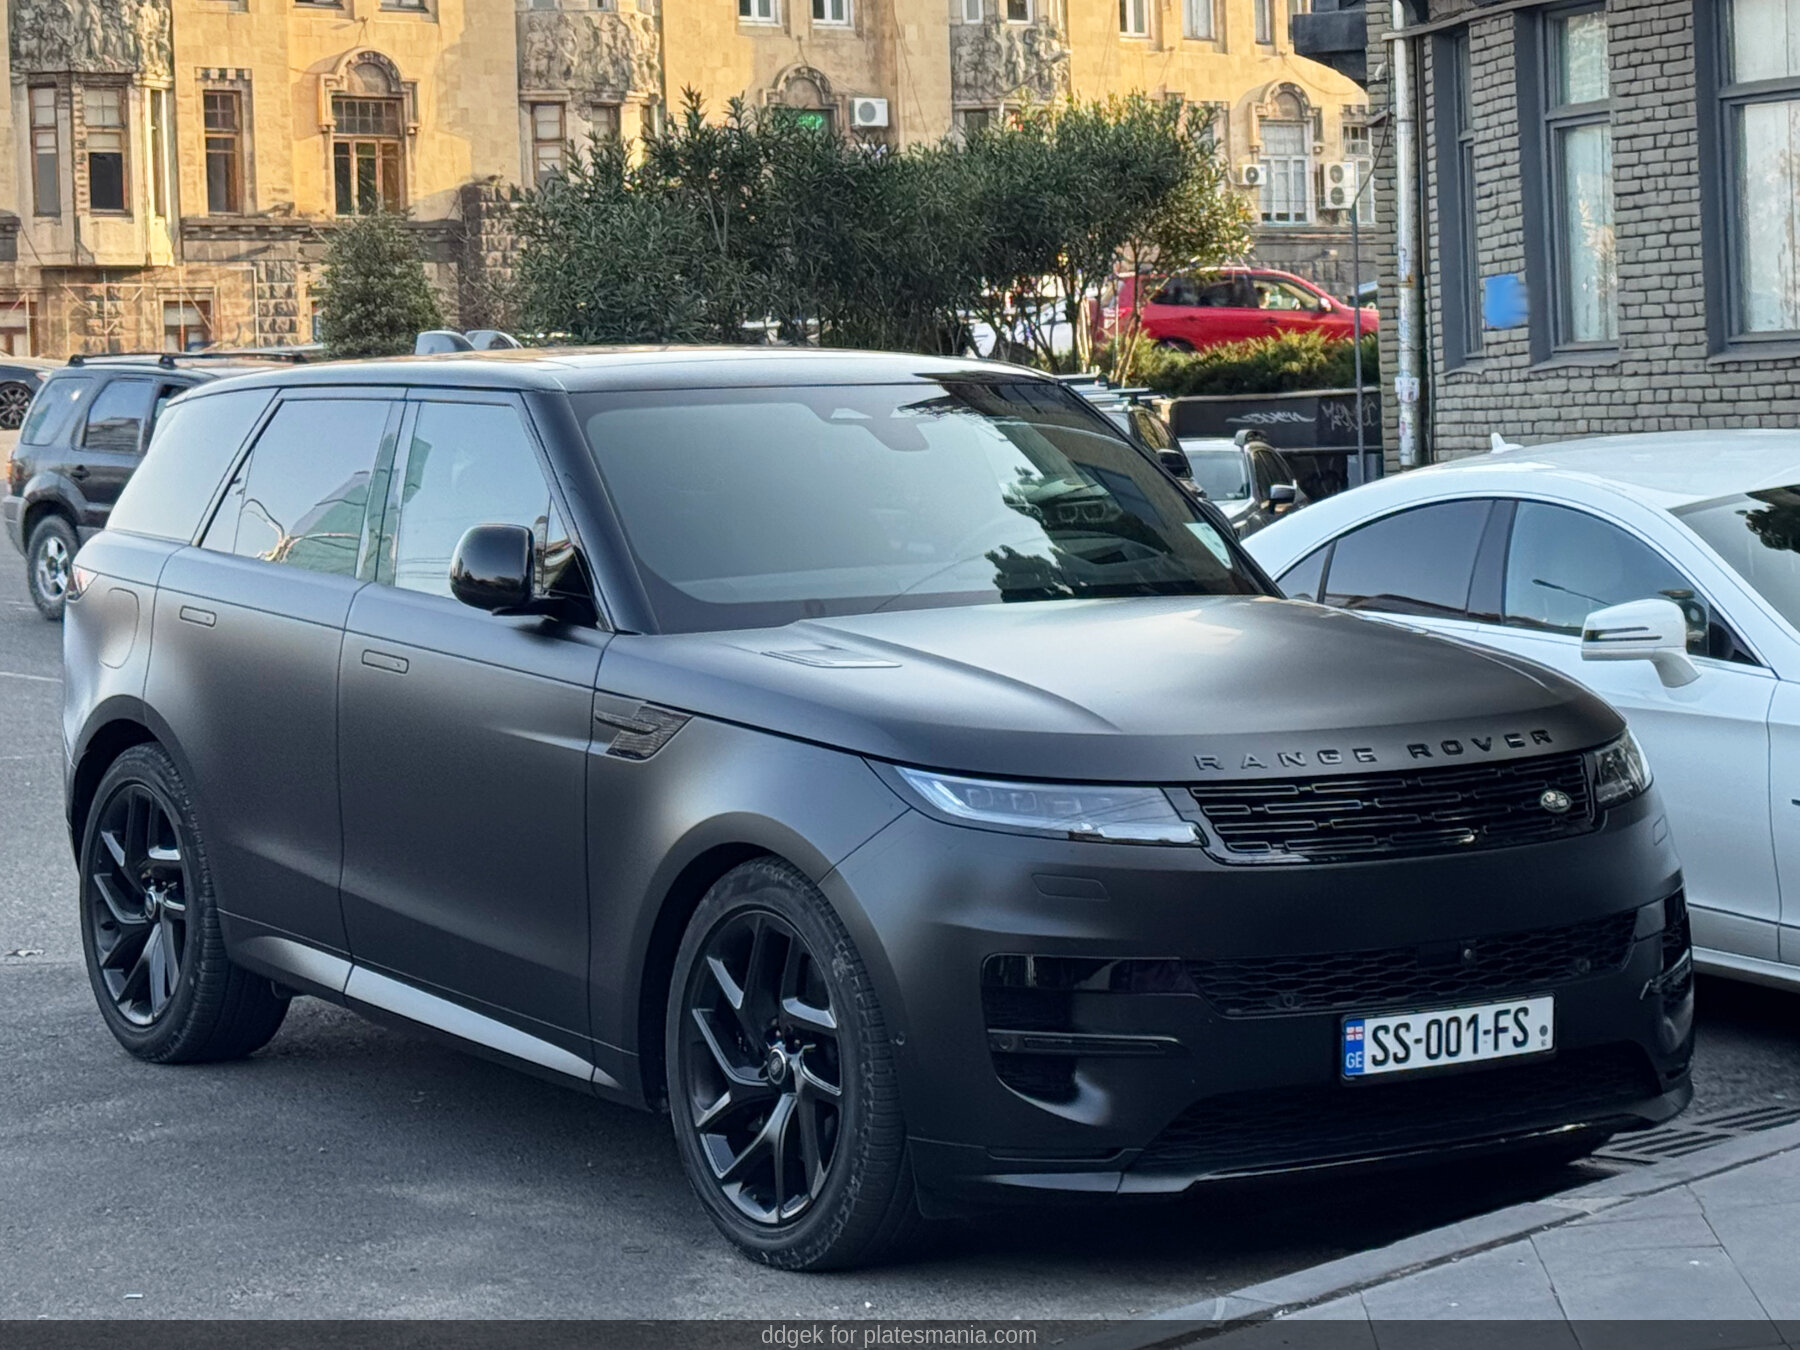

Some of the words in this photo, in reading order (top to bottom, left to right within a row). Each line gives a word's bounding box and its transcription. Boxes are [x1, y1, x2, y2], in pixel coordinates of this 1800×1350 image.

[1193, 747, 1377, 771] RANGE
[1406, 729, 1553, 759] ROVER
[1371, 1006, 1530, 1067] SS-001-FS
[1345, 1051, 1364, 1069] GE
